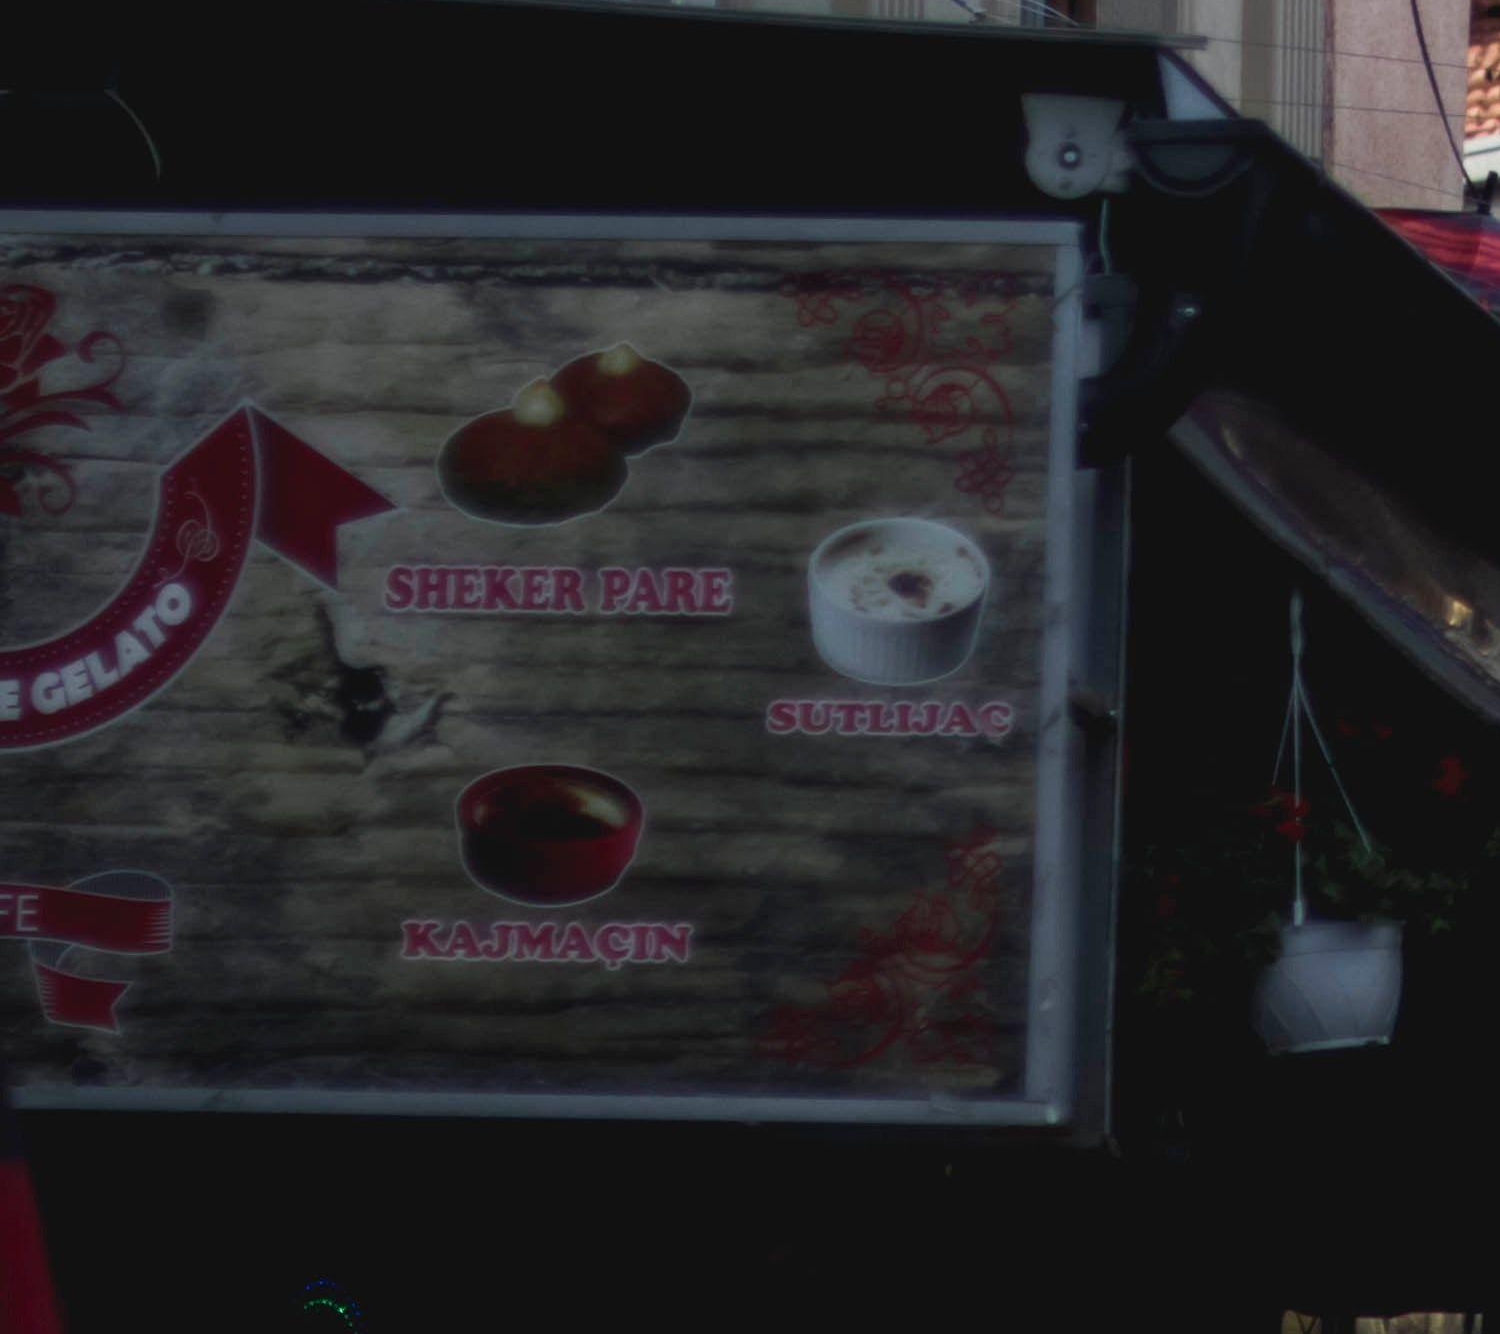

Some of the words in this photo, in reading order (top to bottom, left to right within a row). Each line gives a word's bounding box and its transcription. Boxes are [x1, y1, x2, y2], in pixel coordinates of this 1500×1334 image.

[385, 565, 586, 611] SHEKER
[600, 568, 734, 614] PARE
[31, 582, 193, 715] GELATO
[402, 921, 692, 970] KAJMAÇIN
